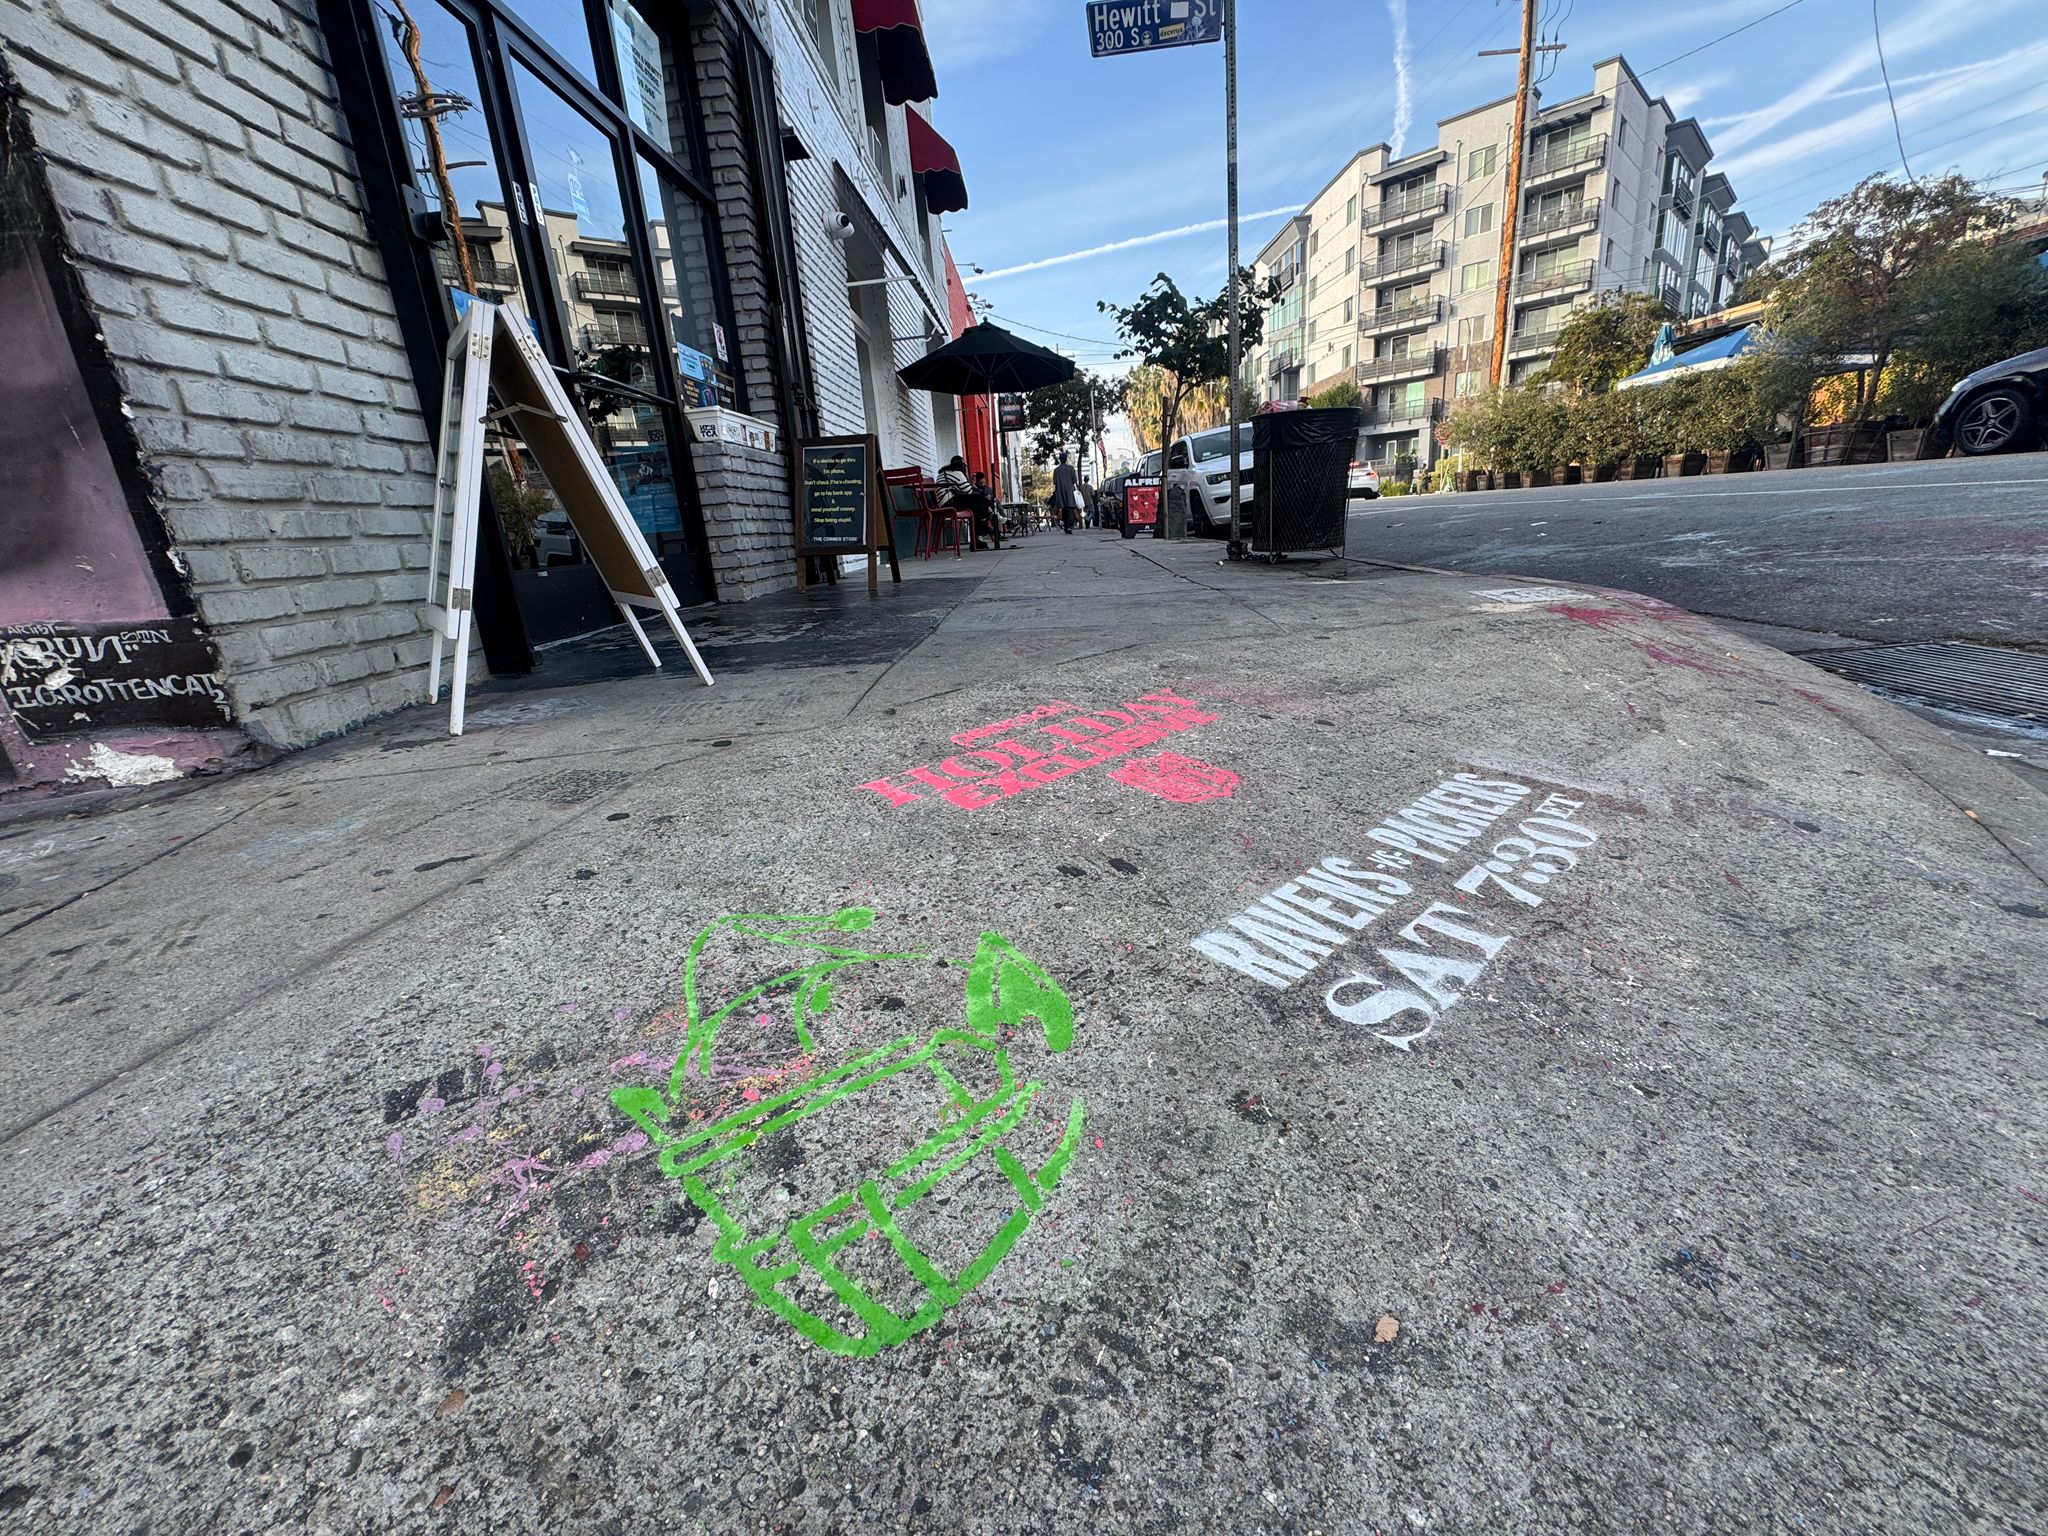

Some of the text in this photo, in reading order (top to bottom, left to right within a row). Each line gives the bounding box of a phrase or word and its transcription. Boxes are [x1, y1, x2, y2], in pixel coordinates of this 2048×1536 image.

[1094, 0, 1161, 32] Hewitt
[1096, 28, 1140, 50] 300 S
[1124, 478, 1162, 486] ALFRE
[853, 687, 1199, 809] HOLIDAY
[941, 711, 1221, 810] EXCLUSIVE
[1188, 856, 1412, 990] RAVENS
[1365, 772, 1531, 864] PACKERS
[1325, 901, 1512, 1052] SAT
